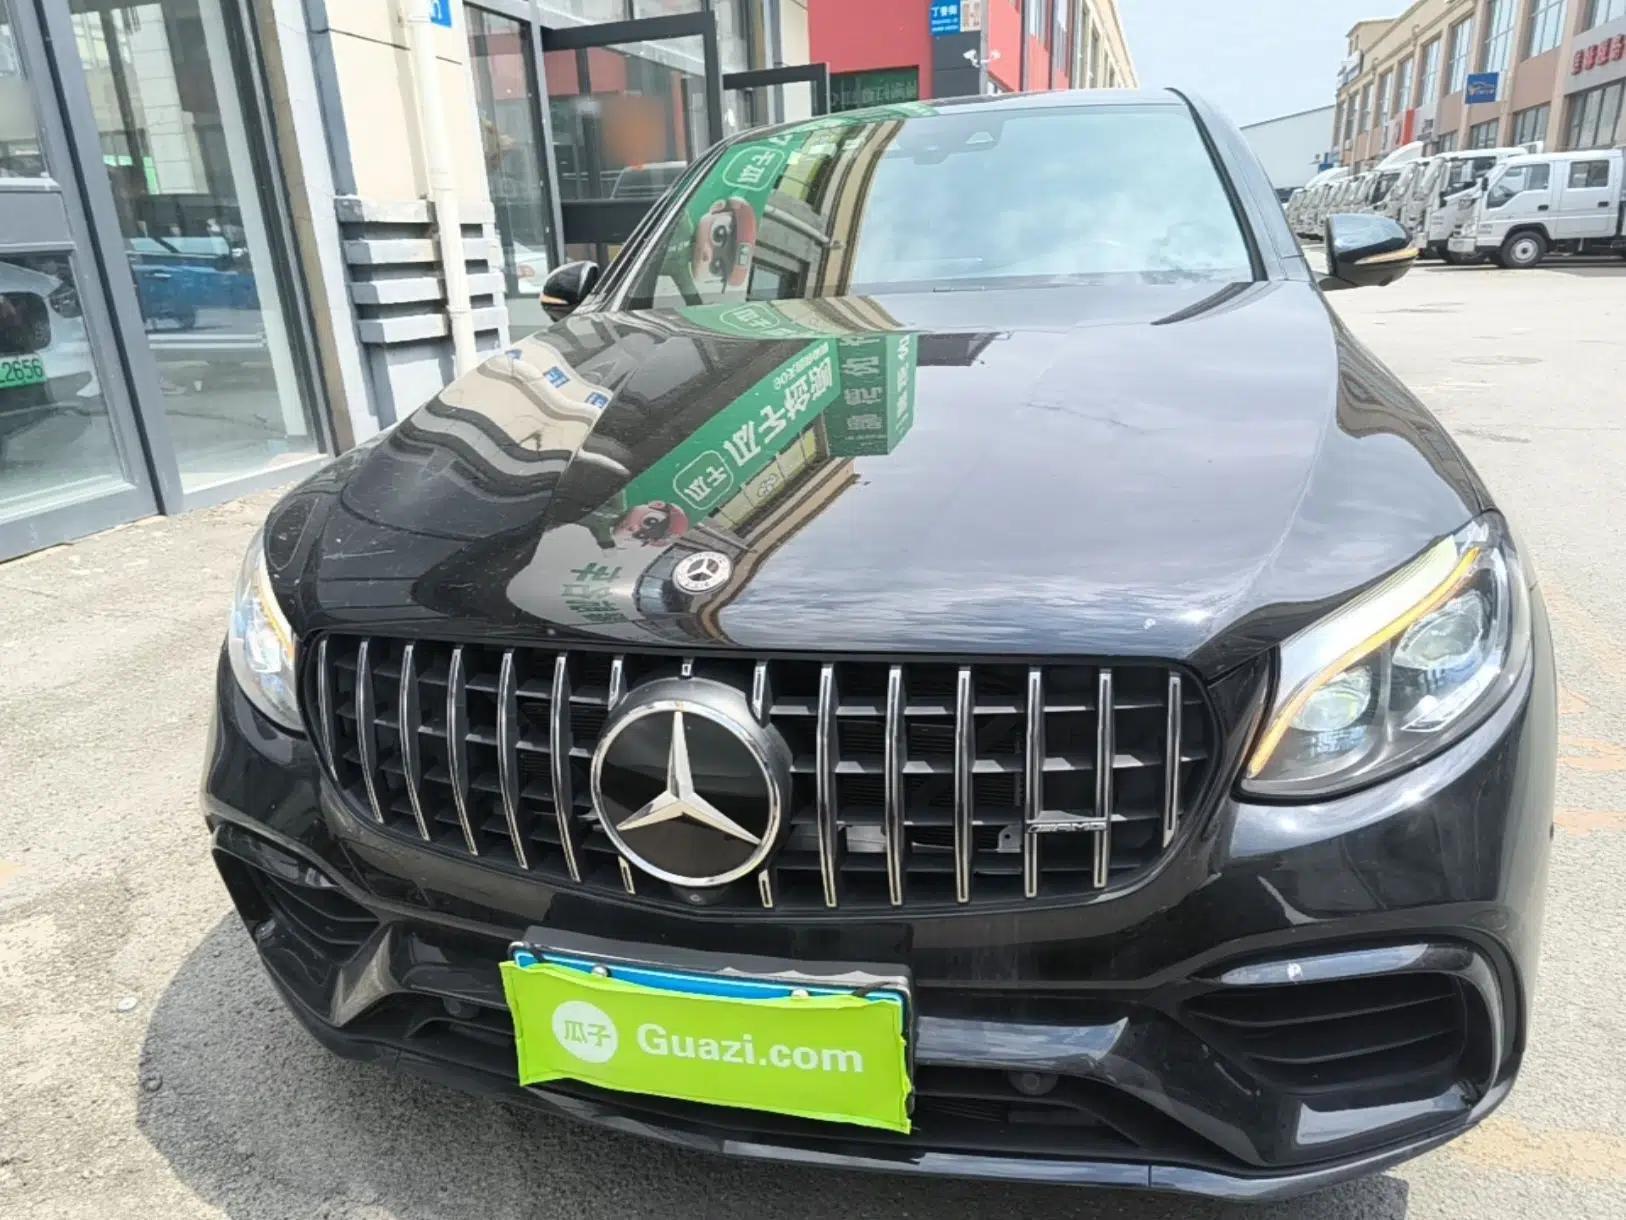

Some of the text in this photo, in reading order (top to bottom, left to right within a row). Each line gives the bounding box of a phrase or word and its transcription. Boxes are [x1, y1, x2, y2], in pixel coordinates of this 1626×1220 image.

[0, 358, 42, 382] 2656
[564, 1019, 611, 1047] 瓜子
[637, 1023, 863, 1072] Guazi.com
